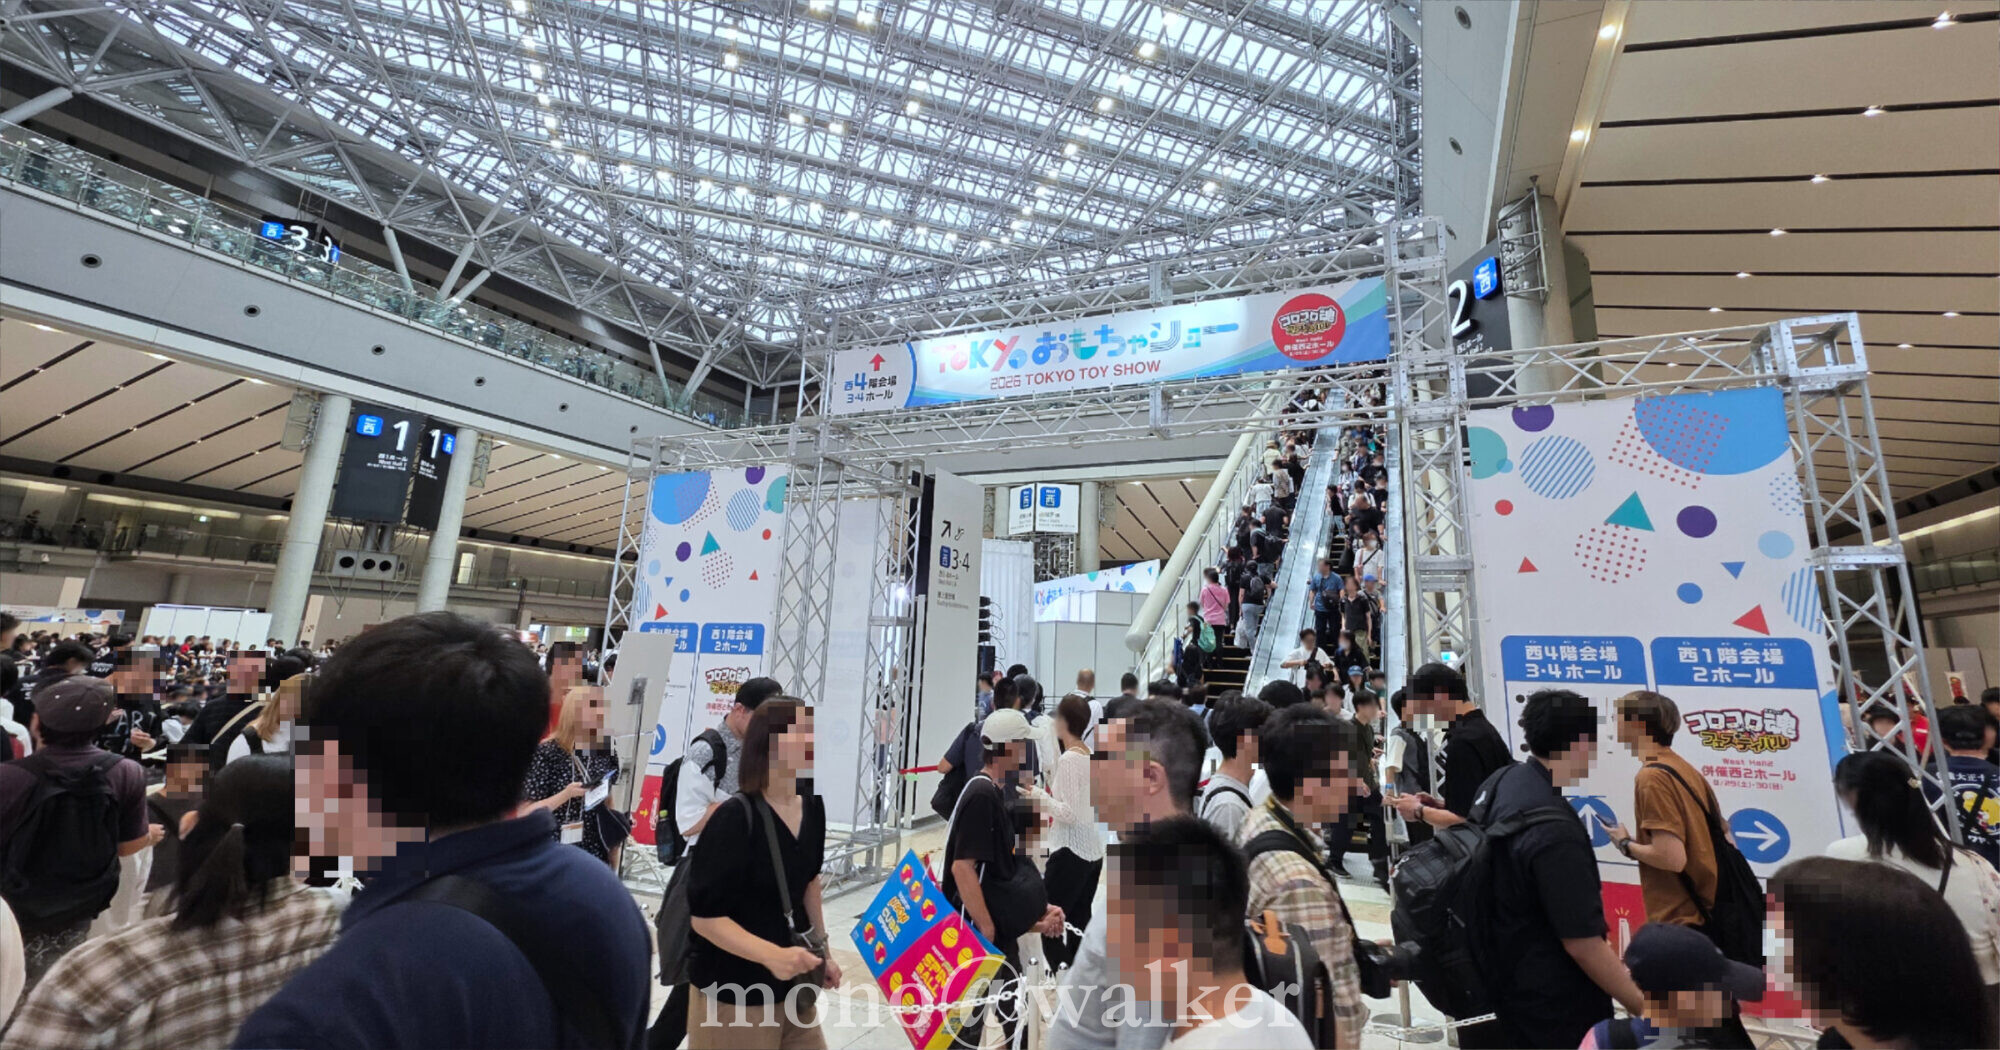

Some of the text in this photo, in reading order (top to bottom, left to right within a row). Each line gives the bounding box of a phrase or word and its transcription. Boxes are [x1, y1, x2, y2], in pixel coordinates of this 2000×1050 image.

[285, 225, 309, 251] 3
[1448, 280, 1471, 336] 2
[844, 372, 897, 391] 西4階会場
[990, 359, 1161, 390] 2026 TOKYO TOY SHOW
[393, 421, 409, 451] 1
[429, 429, 441, 459] 1
[714, 641, 748, 652] 2ホール
[1525, 645, 1618, 662] 西4階会場
[1678, 647, 1784, 665] 西1階会場
[1692, 667, 1775, 684] 2ホール
[1684, 709, 1798, 740] コロコロ魂
[1700, 732, 1790, 753] フェスティバル
